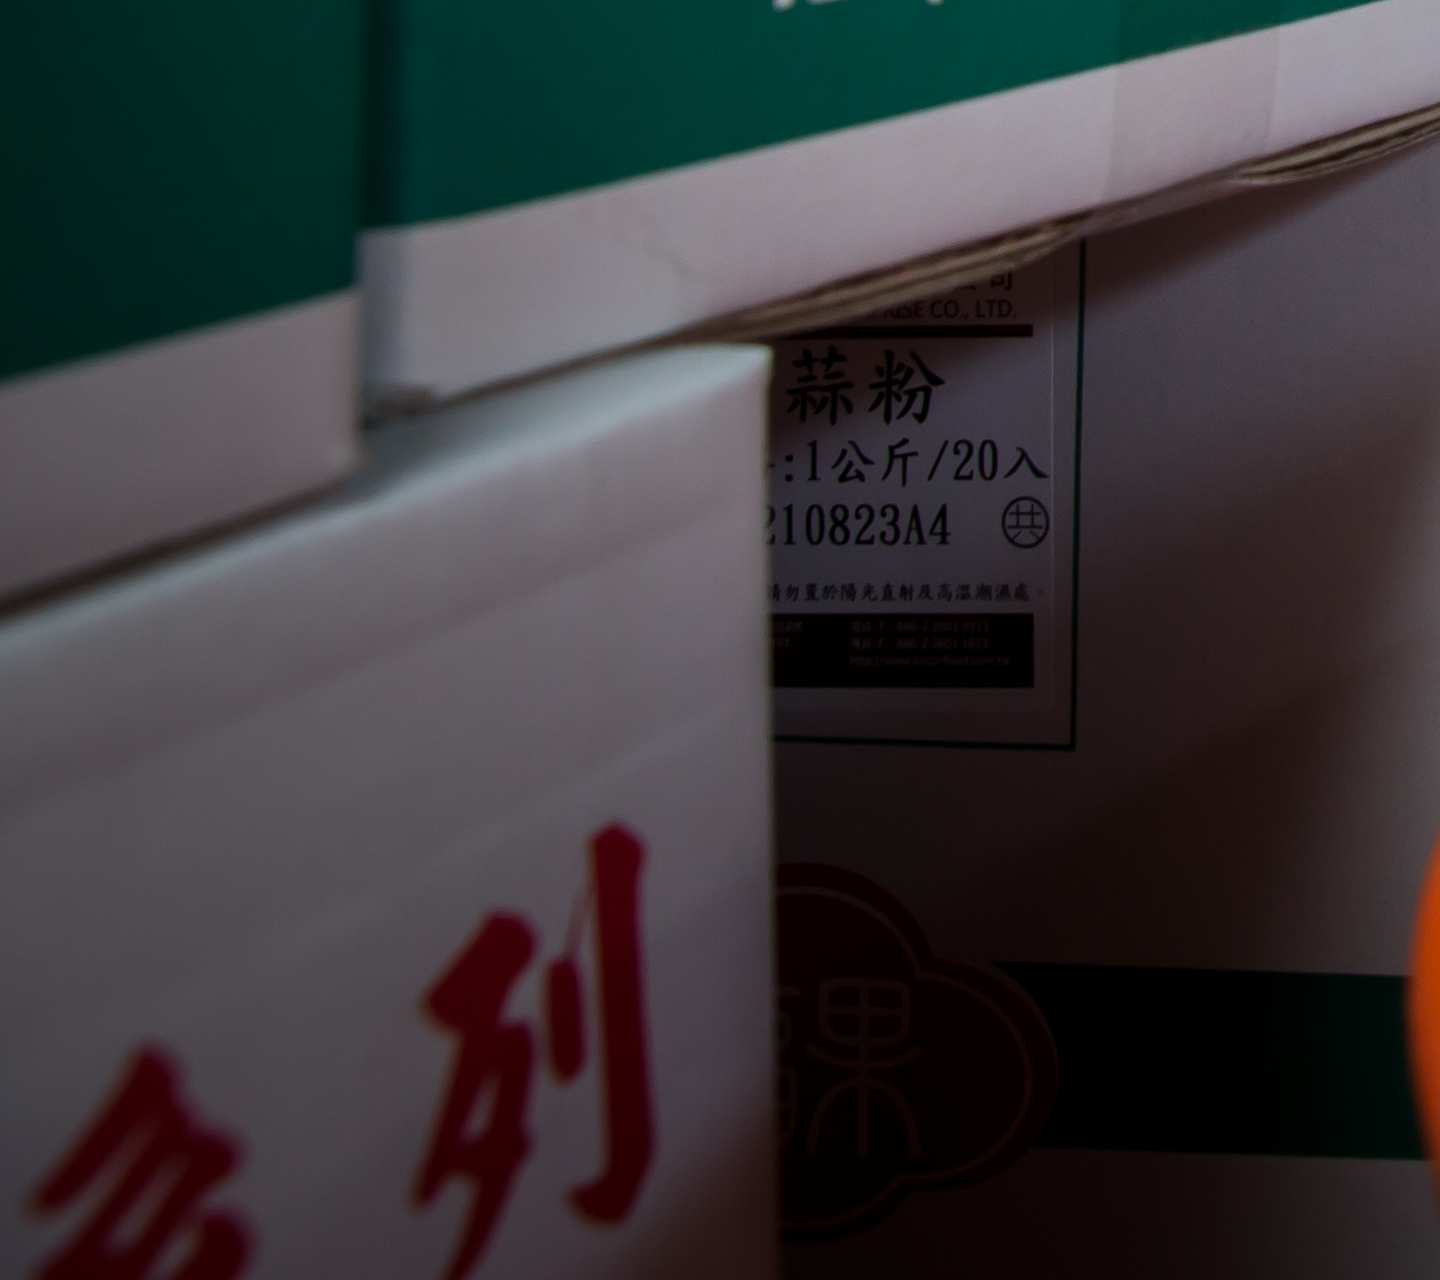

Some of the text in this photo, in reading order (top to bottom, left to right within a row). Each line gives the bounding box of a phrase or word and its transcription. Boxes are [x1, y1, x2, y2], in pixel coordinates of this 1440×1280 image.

[769, 438, 1050, 488] :1公斤/20入
[780, 976, 925, 1160] 果
